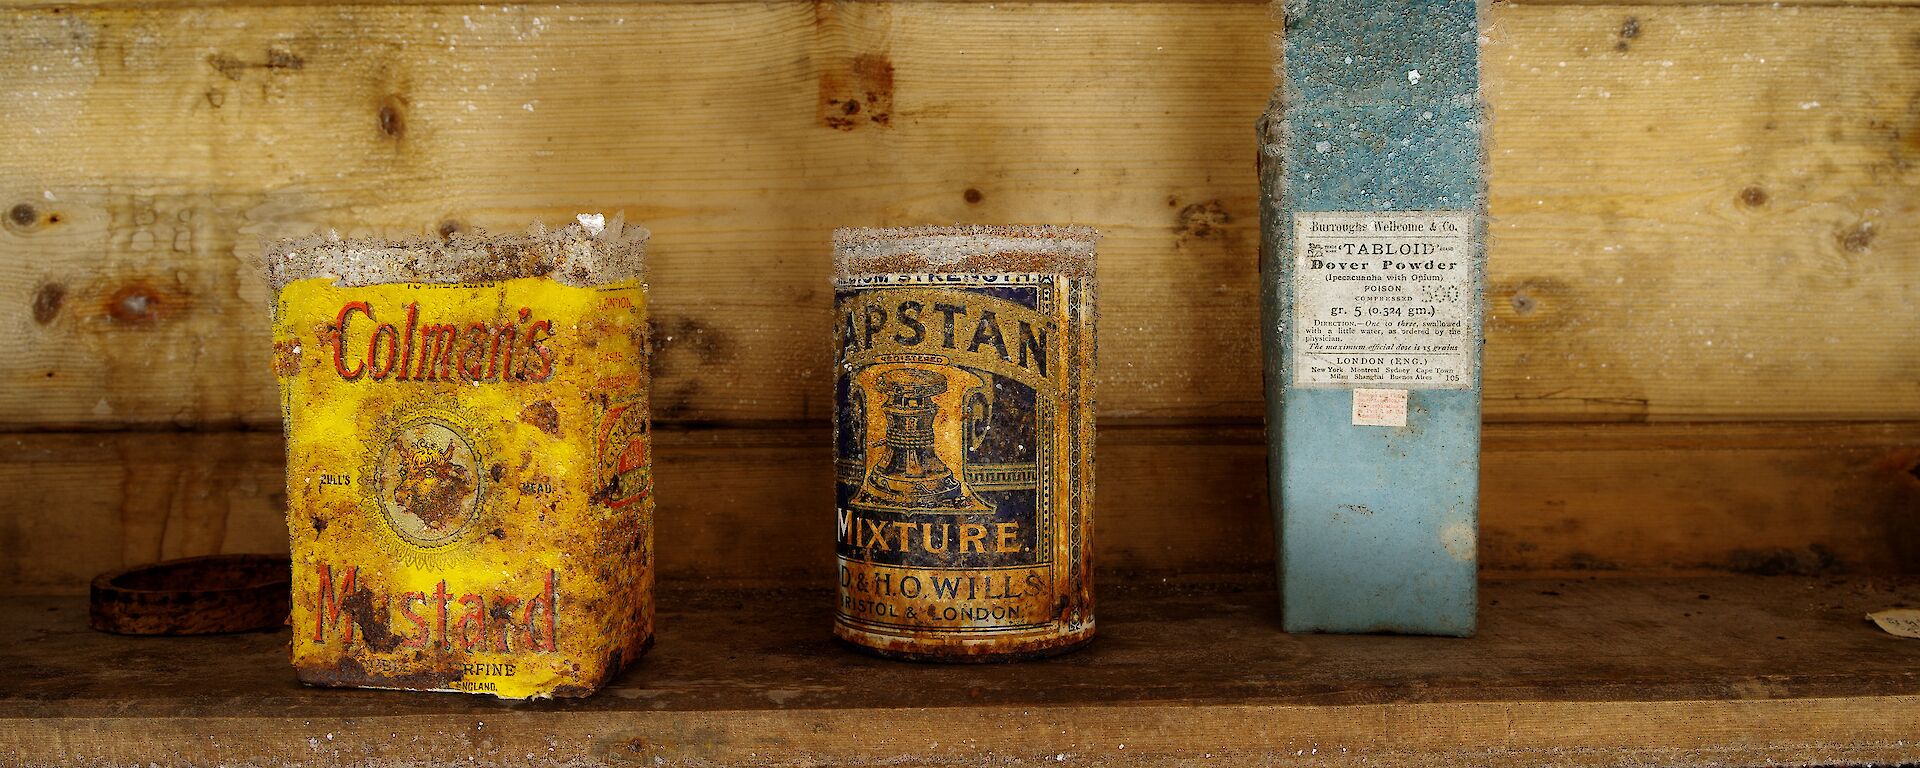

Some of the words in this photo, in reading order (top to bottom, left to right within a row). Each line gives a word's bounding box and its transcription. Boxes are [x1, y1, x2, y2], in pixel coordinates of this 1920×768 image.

[1311, 221, 1368, 234] Burroughs
[1374, 221, 1424, 232] Wellcome
[1429, 222, 1437, 232] &
[1443, 221, 1458, 232] Co.
[1310, 259, 1369, 270] Dover
[1382, 260, 1457, 270] Powder
[1386, 273, 1407, 281] with
[1411, 273, 1443, 282] Opium)
[1330, 307, 1347, 317] gr.
[1354, 306, 1362, 317] 5
[1368, 306, 1402, 317] (0.324
[1408, 305, 1436, 317] gm.)
[1397, 319, 1419, 327] three,
[1422, 319, 1461, 327] swallowed
[1305, 326, 1322, 334] with
[1338, 326, 1356, 334] little
[1360, 328, 1384, 336] water,
[1401, 327, 1430, 335] ordered
[1434, 327, 1444, 336] by
[1449, 327, 1461, 335] the
[332, 301, 556, 384] Colman's
[1305, 334, 1343, 343] physician.
[1308, 342, 1323, 350] The
[1367, 342, 1395, 351] official
[1395, 343, 1412, 351] dose
[1413, 343, 1421, 351] is
[1432, 343, 1458, 352] grains
[1336, 357, 1384, 365] LONDON
[1390, 357, 1428, 365] (ENG.)
[1385, 366, 1411, 374] Sydney
[1415, 367, 1433, 375] Cape
[1445, 374, 1460, 382] 105
[314, 563, 558, 654] Mstard
[906, 606, 918, 620] &
